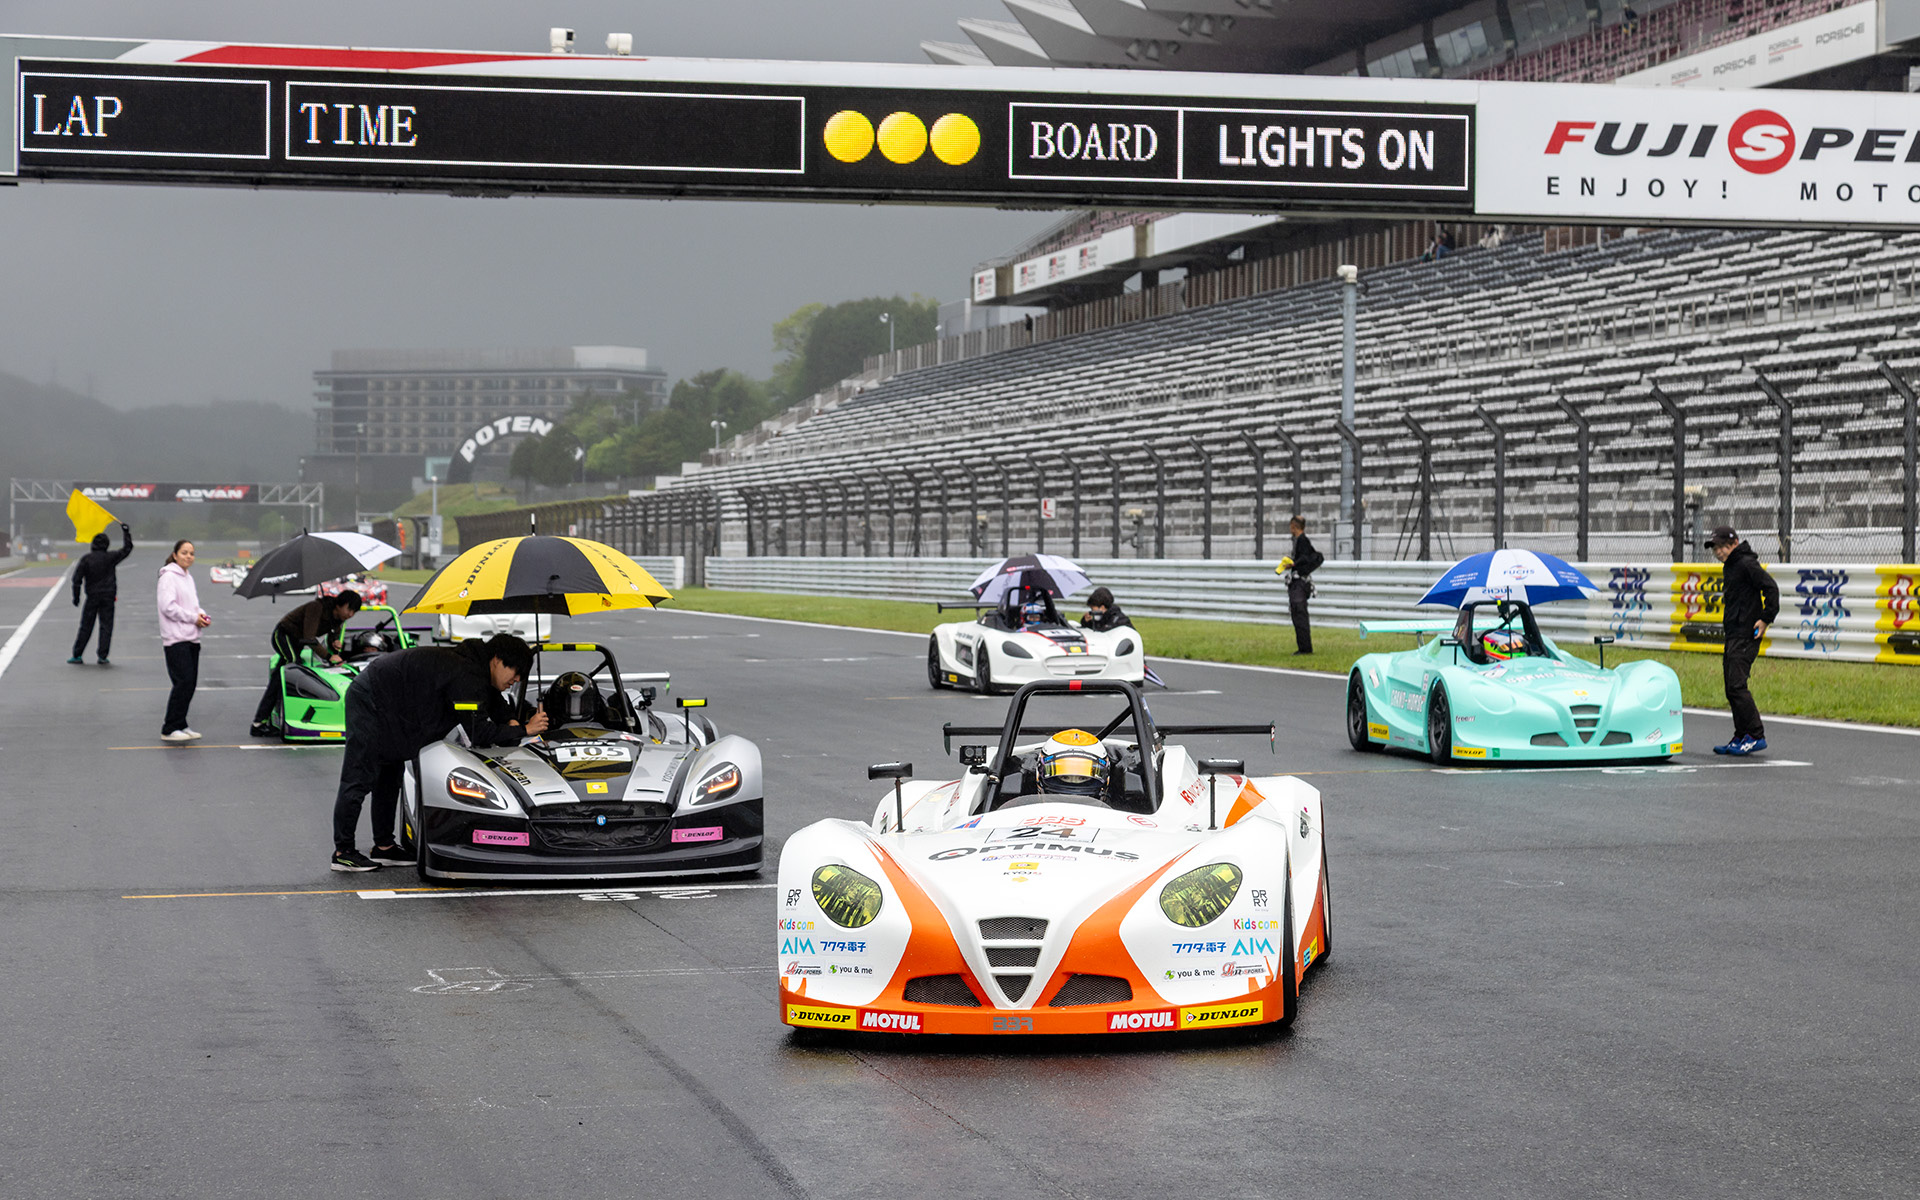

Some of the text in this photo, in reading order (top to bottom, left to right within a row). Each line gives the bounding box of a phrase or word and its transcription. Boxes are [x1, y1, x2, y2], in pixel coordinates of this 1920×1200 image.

[1816, 22, 1865, 46] PORSCHE
[1713, 54, 1757, 76] PORSCHE
[33, 94, 123, 137] LAP
[300, 102, 418, 147] TIME
[1030, 121, 1158, 162] BOARD
[1219, 124, 1435, 171] LIGHTS ON
[1543, 120, 1719, 159] FUJI
[1547, 176, 1728, 199] ENJOY!
[82, 487, 148, 498] ADVAN
[176, 488, 242, 499] ADVAN
[466, 539, 511, 586] DUNLOP
[565, 747, 624, 757] 105
[1456, 748, 1484, 756] DUNLOP
[1006, 827, 1076, 840] 24
[928, 842, 1140, 861] OPTIMUS
[780, 936, 816, 955] AIM
[1231, 937, 1275, 956] AIM
[839, 965, 873, 975] you & me
[1177, 968, 1215, 979] you & me
[797, 1010, 851, 1024] DUNLOP
[862, 1011, 921, 1031] MOTUL
[1110, 1011, 1175, 1030] MOTUL
[1198, 1007, 1259, 1022] DUNLOP
